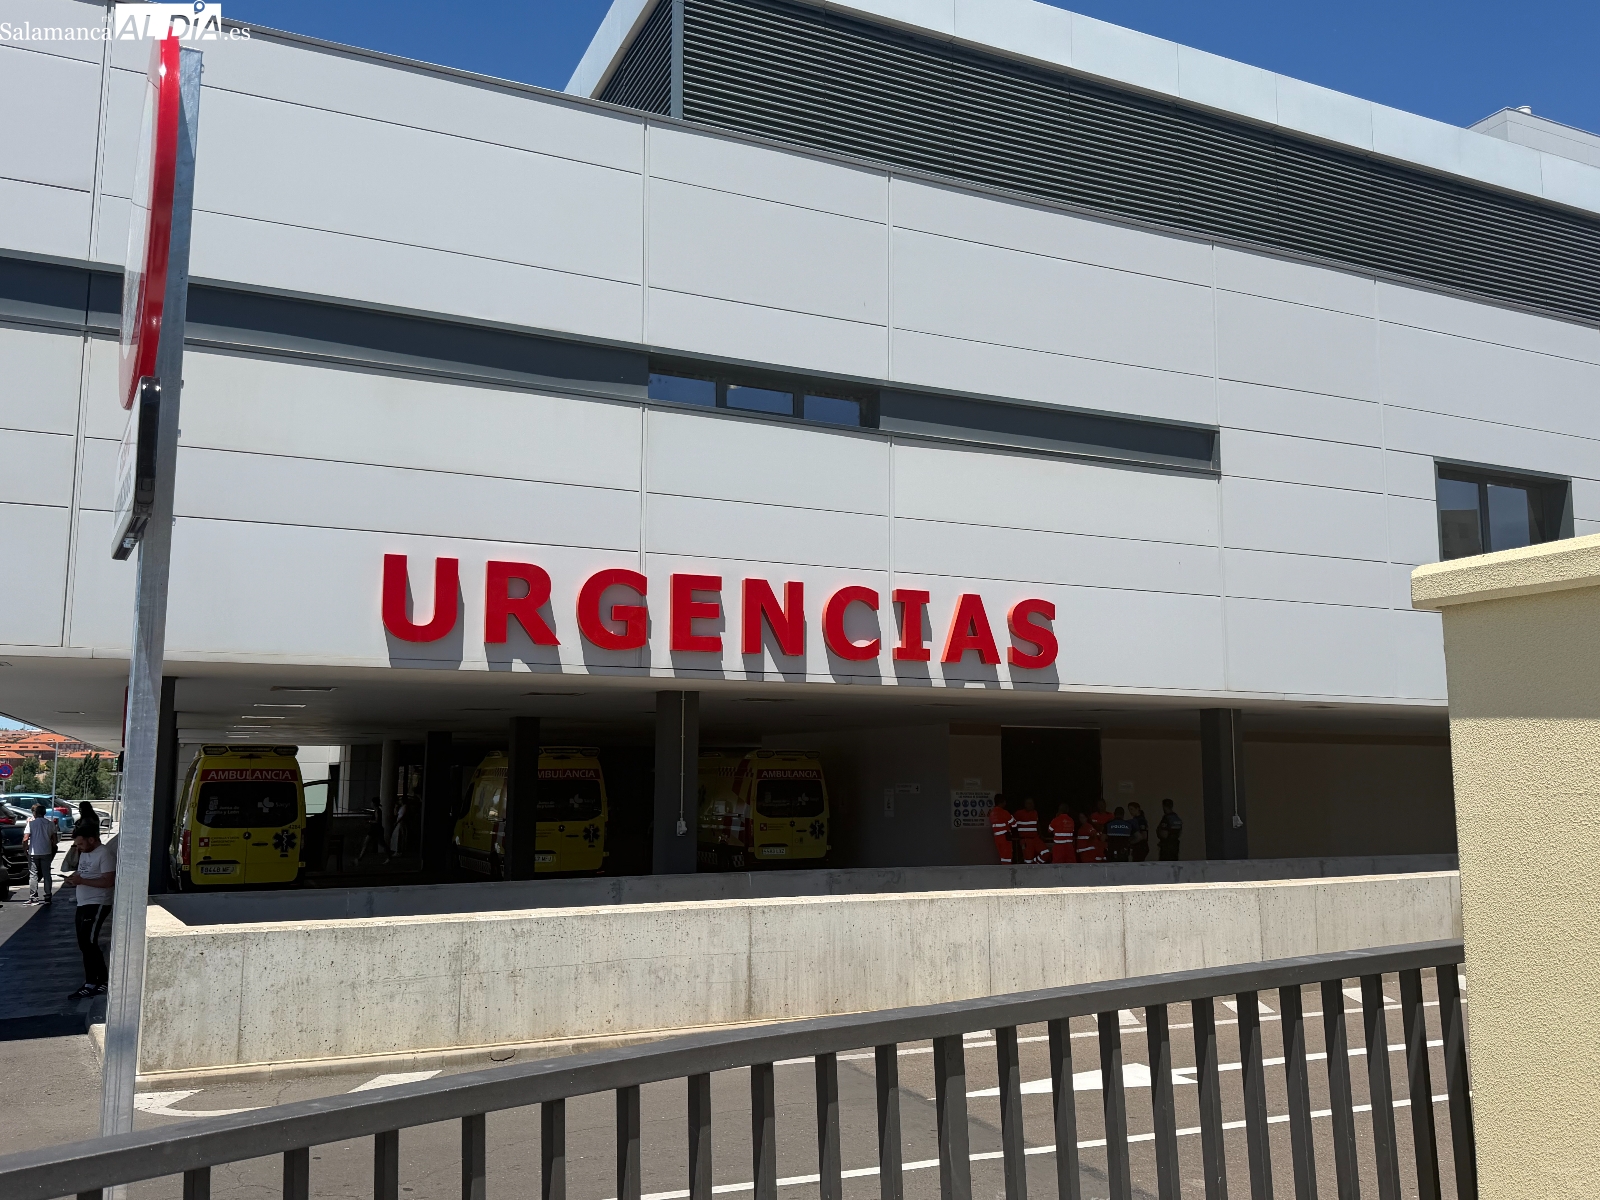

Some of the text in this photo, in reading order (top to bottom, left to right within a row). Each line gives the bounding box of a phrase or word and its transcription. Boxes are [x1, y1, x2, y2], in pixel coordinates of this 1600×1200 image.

[381, 553, 1059, 669] URGENCIAS
[207, 770, 292, 780] AMBULANCIA
[537, 769, 596, 779] MBULANCIA
[761, 770, 818, 778] AMBULANCIA
